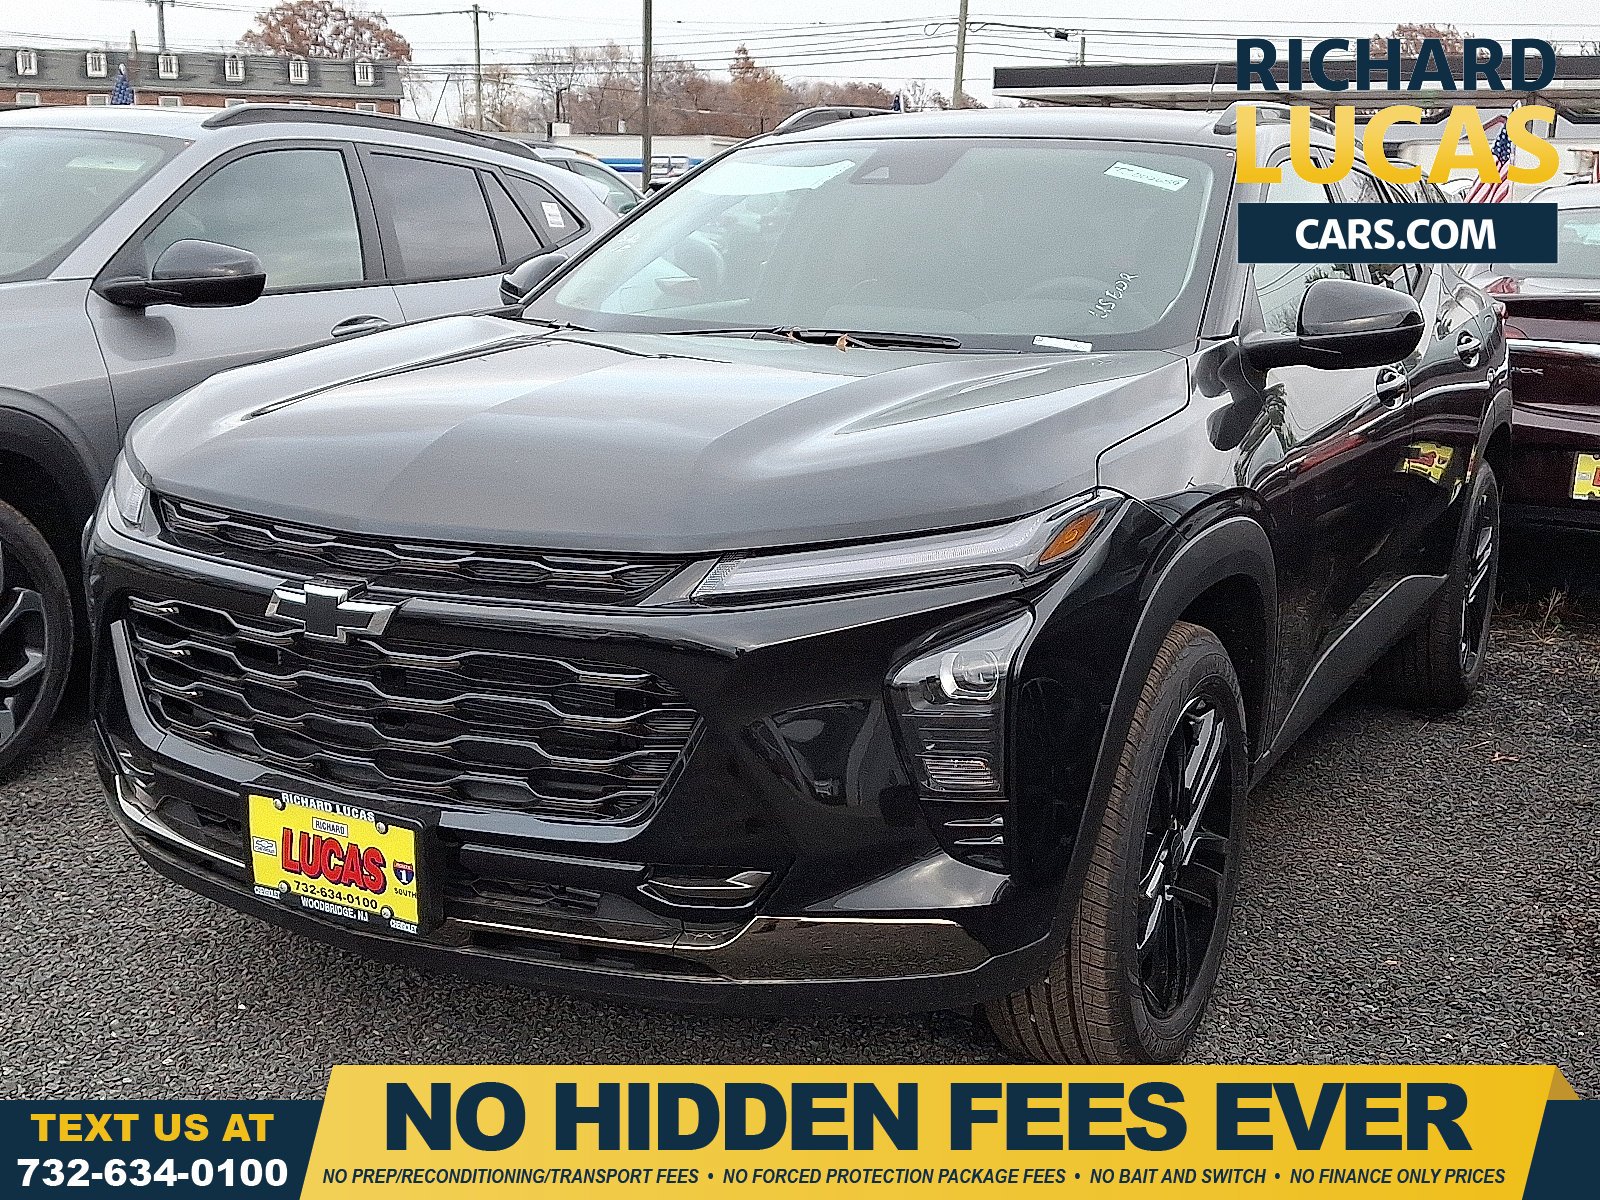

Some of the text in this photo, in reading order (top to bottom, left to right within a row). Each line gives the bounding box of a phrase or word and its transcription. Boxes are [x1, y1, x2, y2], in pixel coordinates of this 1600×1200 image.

[281, 792, 375, 822] RICHARD LUCAS
[315, 820, 345, 835] RICHARD
[281, 827, 387, 894] LUCAS
[399, 869, 409, 884] 1
[293, 880, 378, 909] 732-634-0100
[394, 886, 417, 900] SOUTH
[358, 910, 369, 922] NJ
